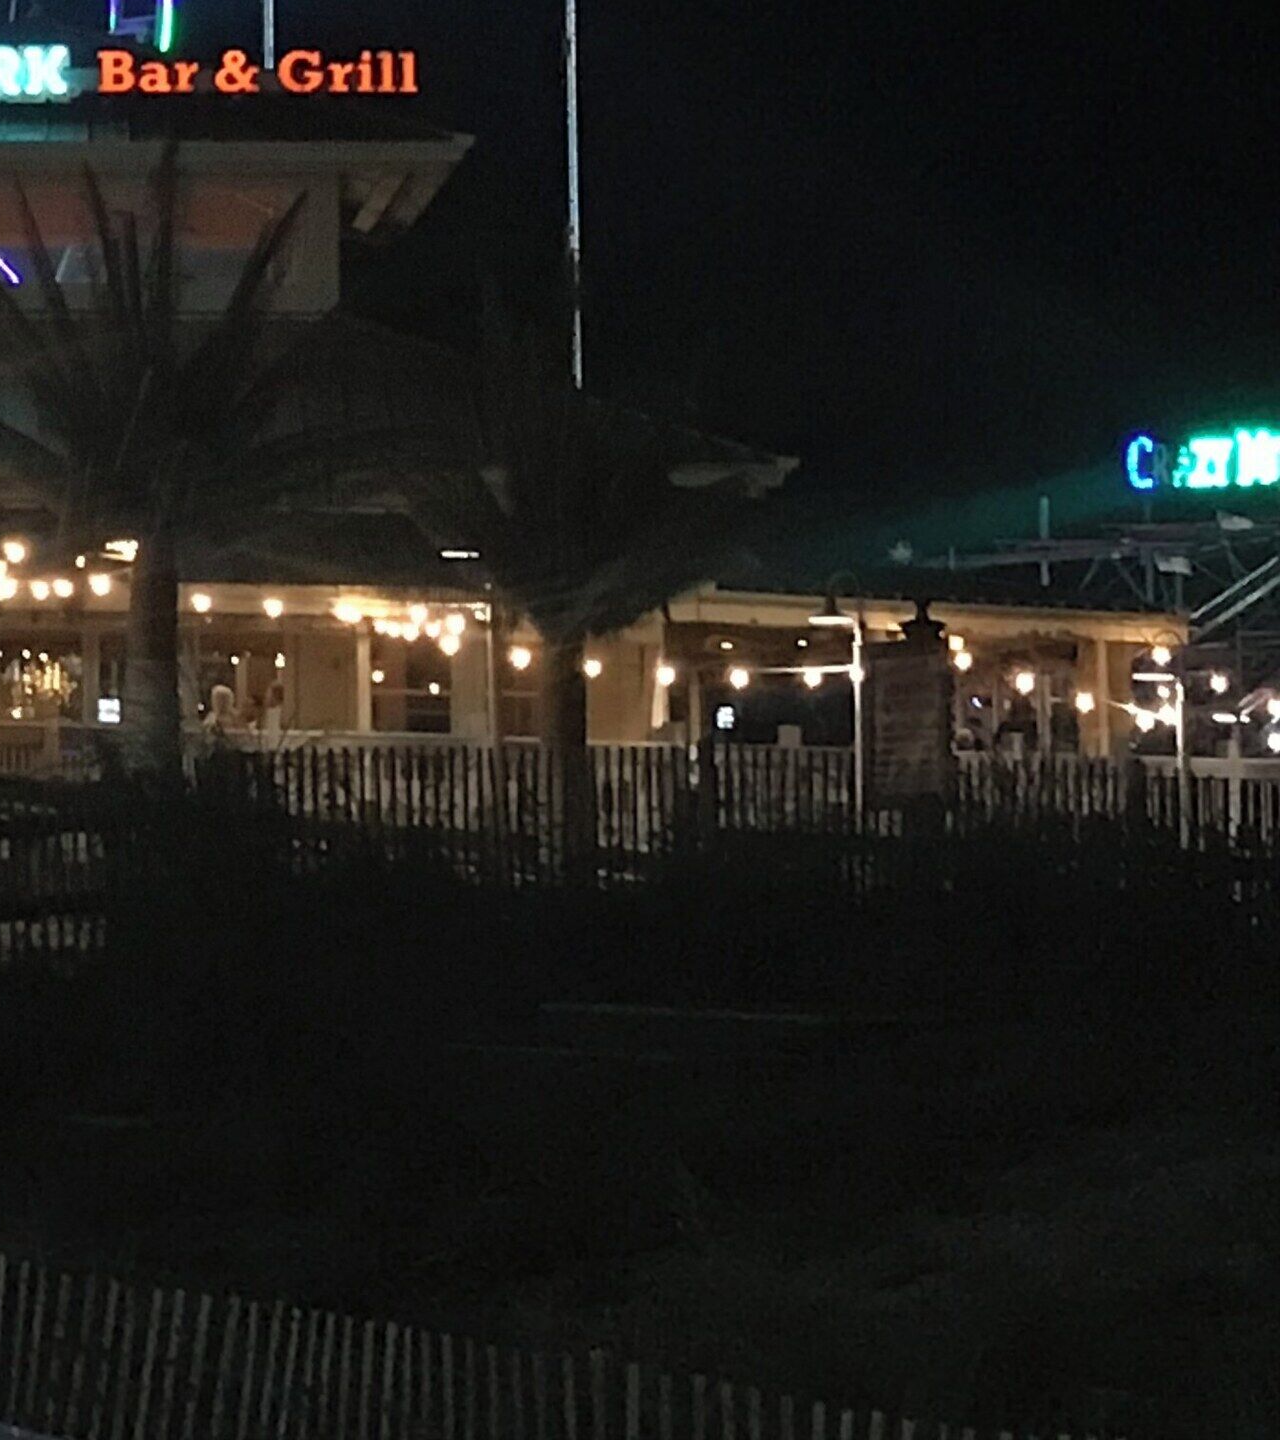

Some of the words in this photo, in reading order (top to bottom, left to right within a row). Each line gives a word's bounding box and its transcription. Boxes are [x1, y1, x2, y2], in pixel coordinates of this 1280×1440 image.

[96, 48, 199, 93] Bar
[213, 48, 260, 93] &
[276, 48, 418, 93] Grill
